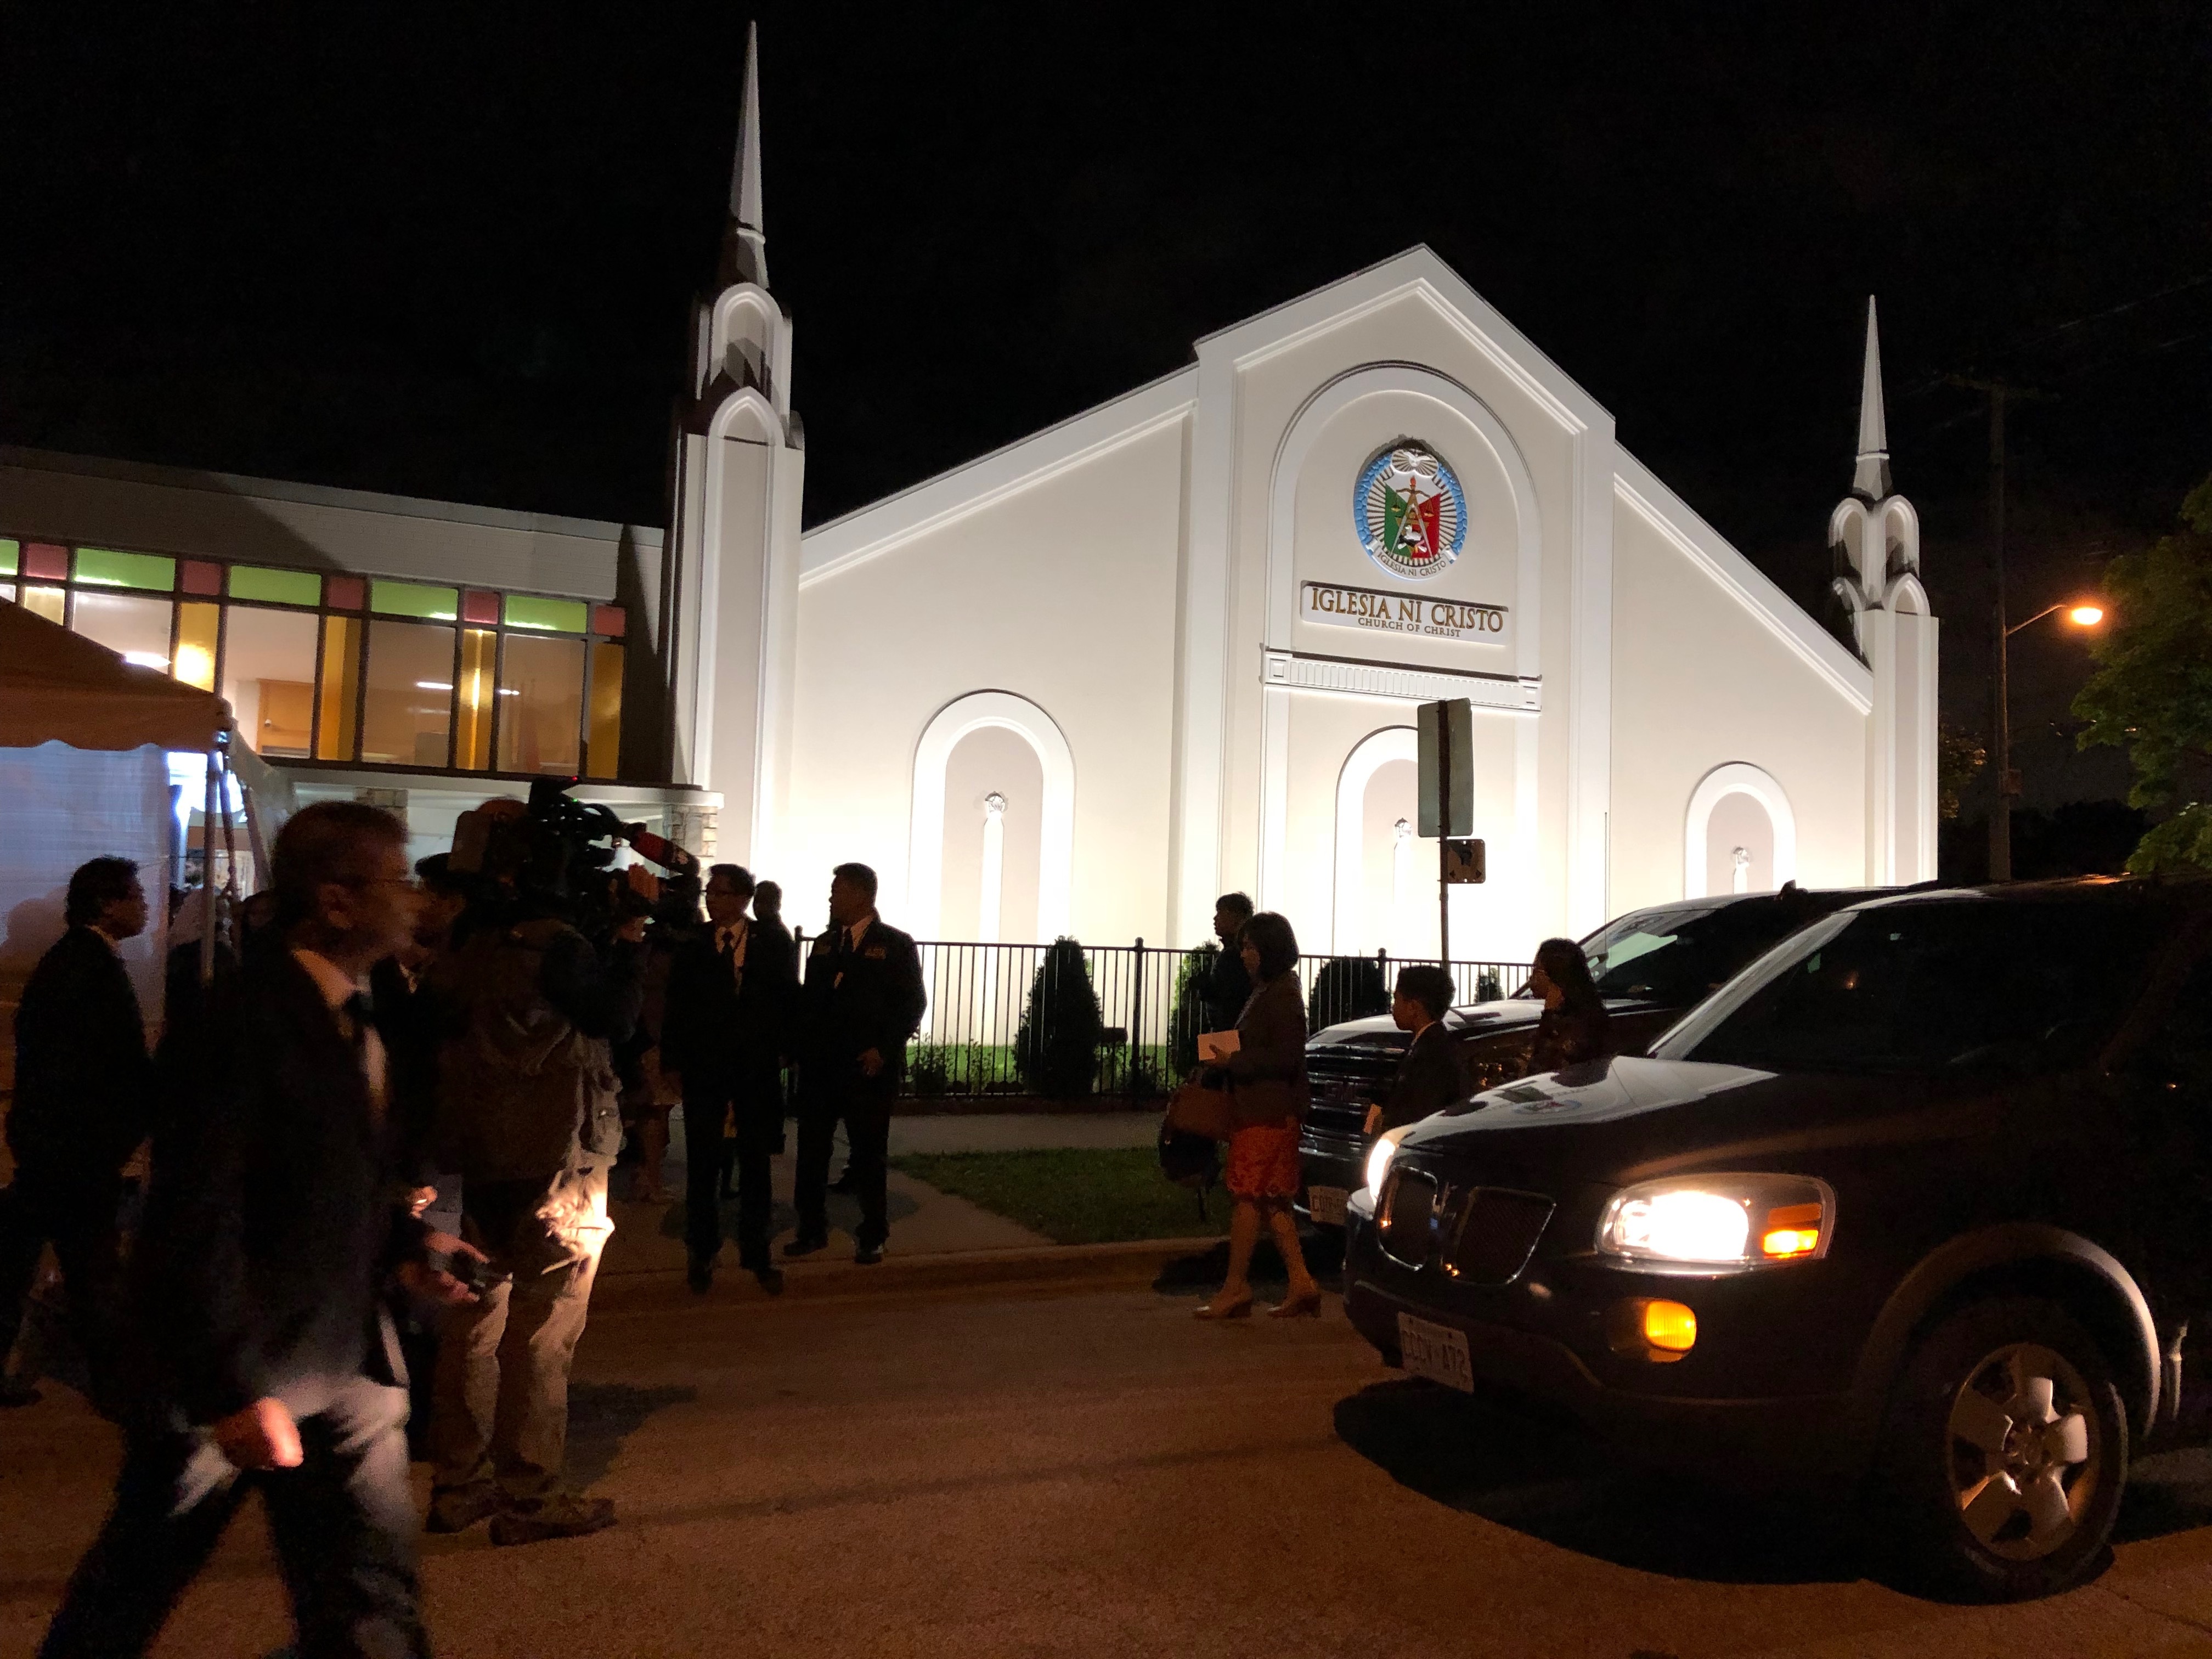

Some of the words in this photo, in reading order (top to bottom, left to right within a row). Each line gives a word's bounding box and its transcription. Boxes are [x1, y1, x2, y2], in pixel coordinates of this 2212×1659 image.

[1378, 551, 1406, 575] IGLESIA
[1408, 568, 1417, 577] NI
[1420, 560, 1446, 577] CRISTO
[1312, 588, 1391, 620] IGLESIA
[1398, 599, 1422, 624] NI
[1431, 603, 1504, 633] CRISTO
[1358, 617, 1403, 630] CHURCH
[1407, 622, 1420, 632] OF
[1424, 625, 1461, 638] CHRIST
